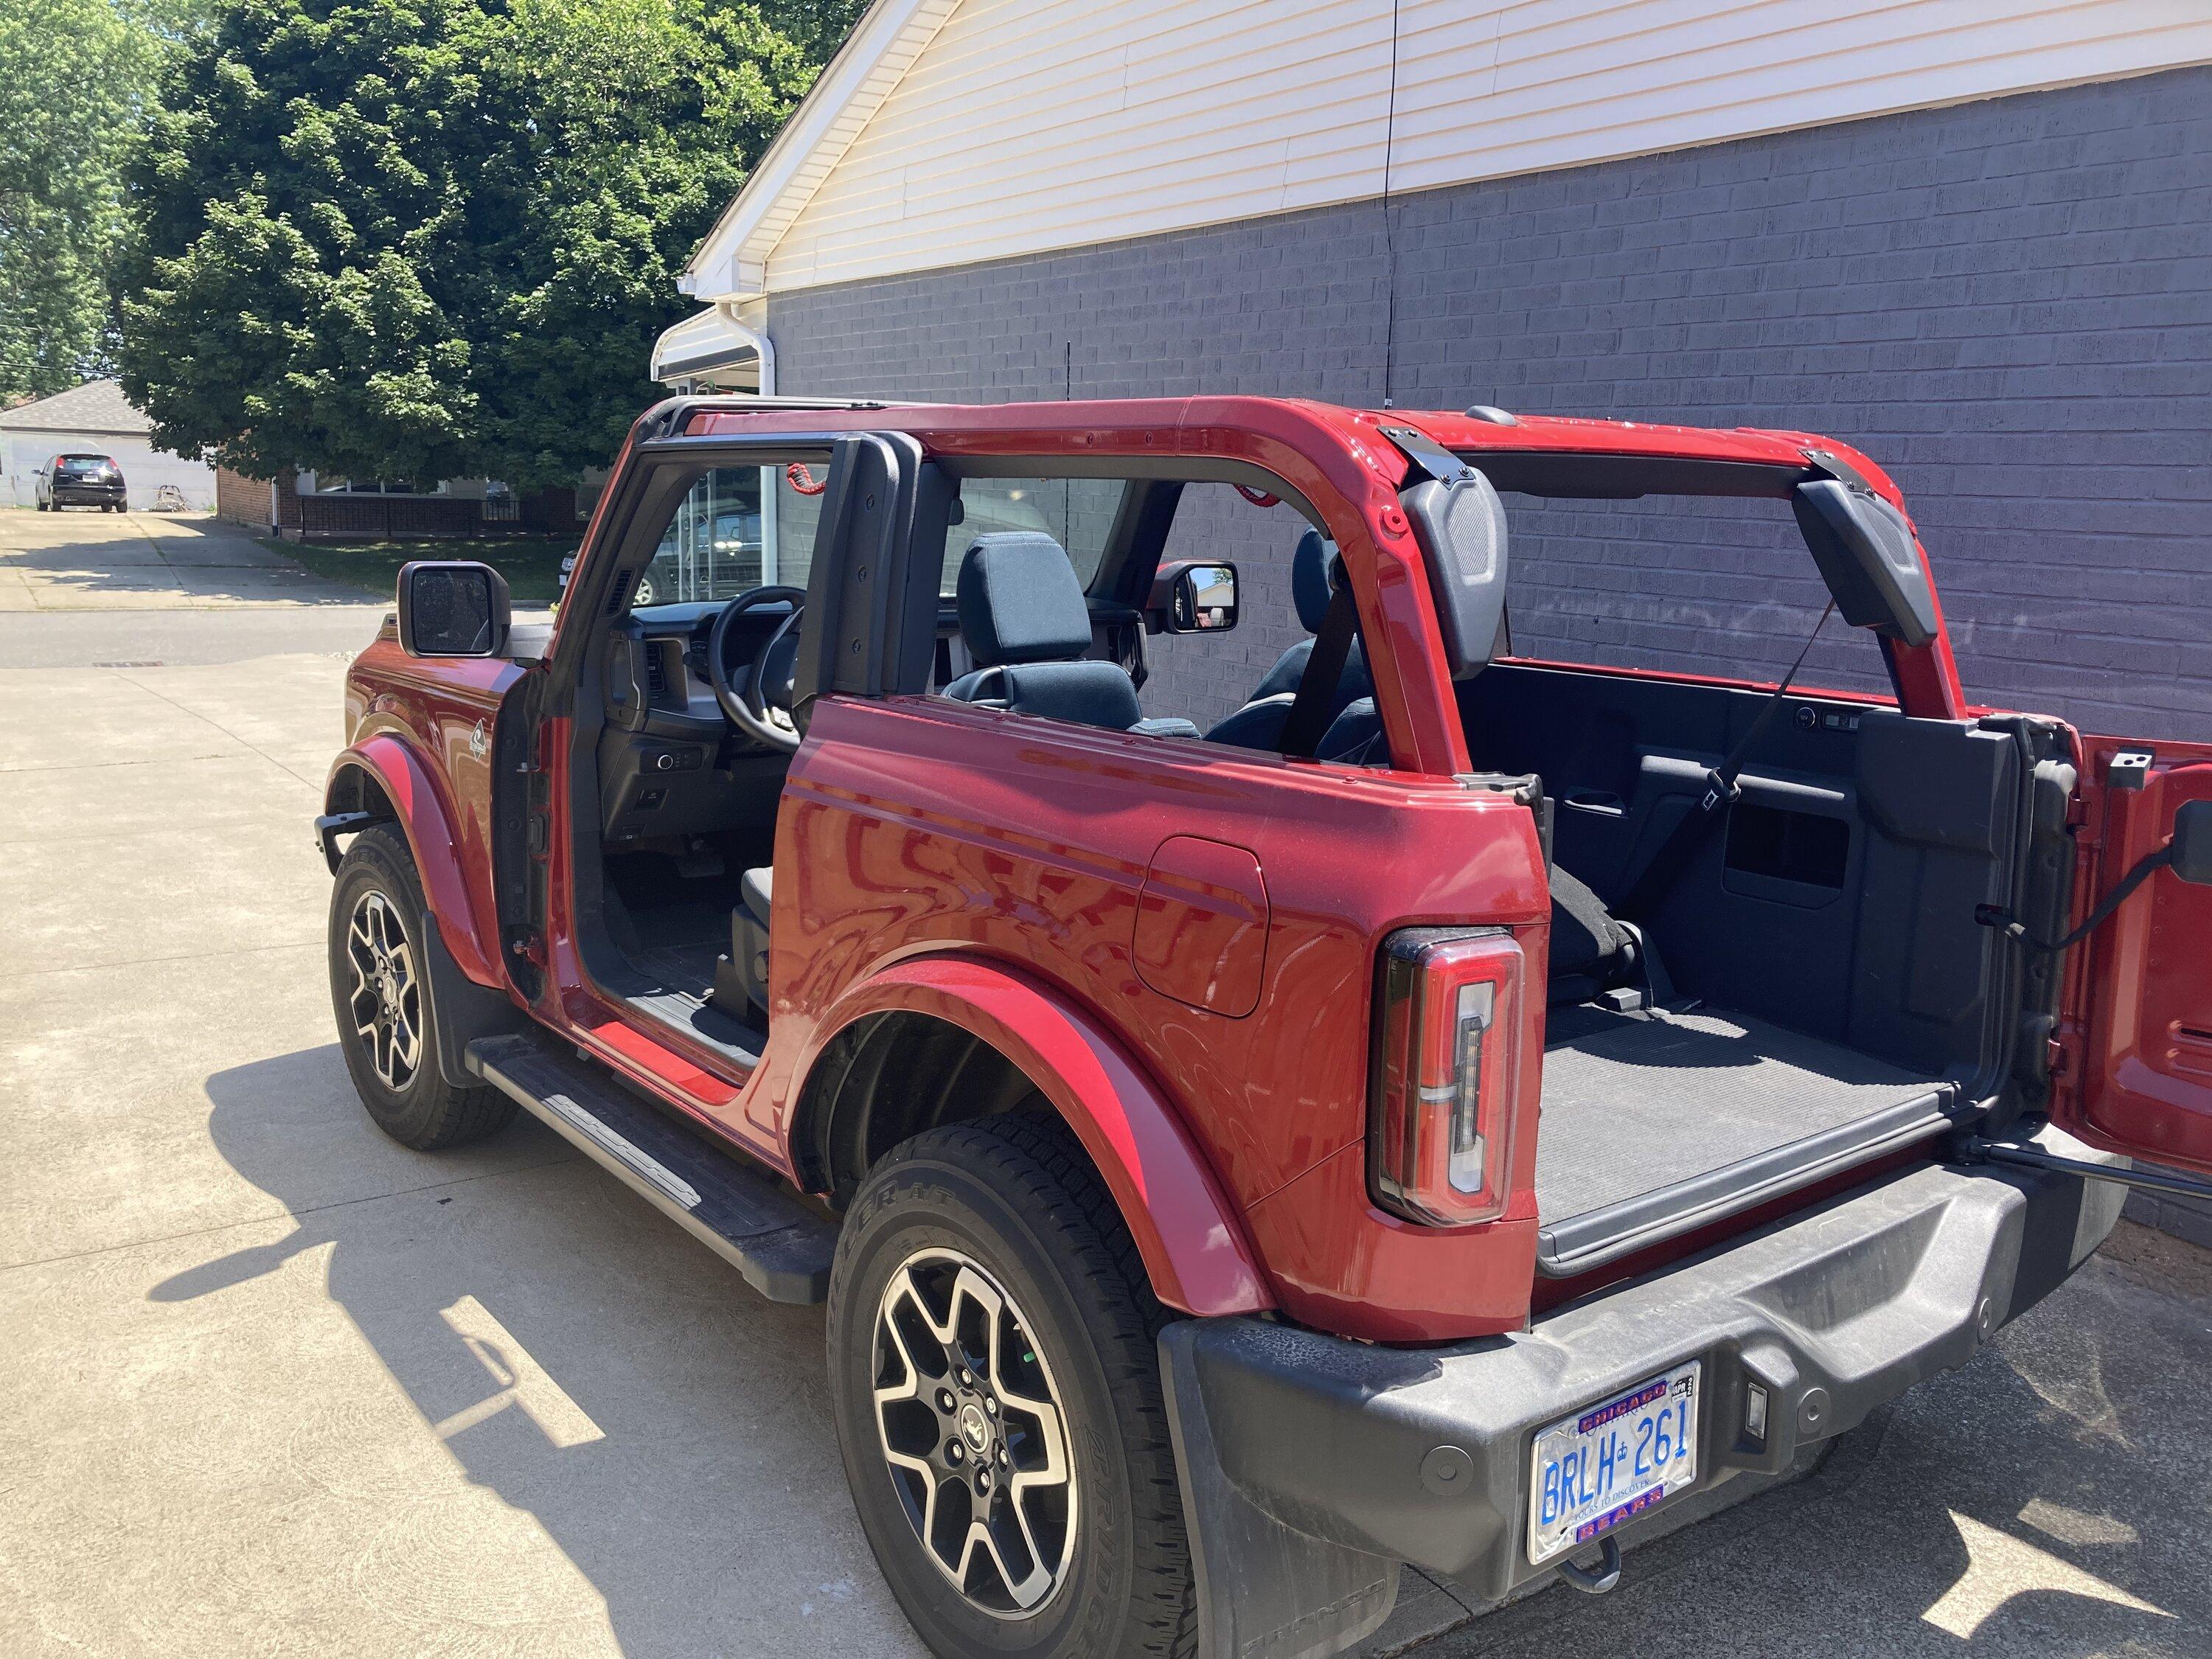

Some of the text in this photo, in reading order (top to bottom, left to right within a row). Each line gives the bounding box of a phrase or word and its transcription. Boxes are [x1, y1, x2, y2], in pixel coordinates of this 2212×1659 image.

[1582, 1384, 1666, 1432] CHICAGO
[1673, 1382, 1686, 1395] APR
[1541, 1430, 1617, 1526] BRLH
[1634, 1399, 1688, 1478] 261
[1574, 1478, 1651, 1520] YOURS TO DISCOVER
[1579, 1488, 1663, 1540] BEARS
[1064, 1423, 1117, 1659] BRIDGE
